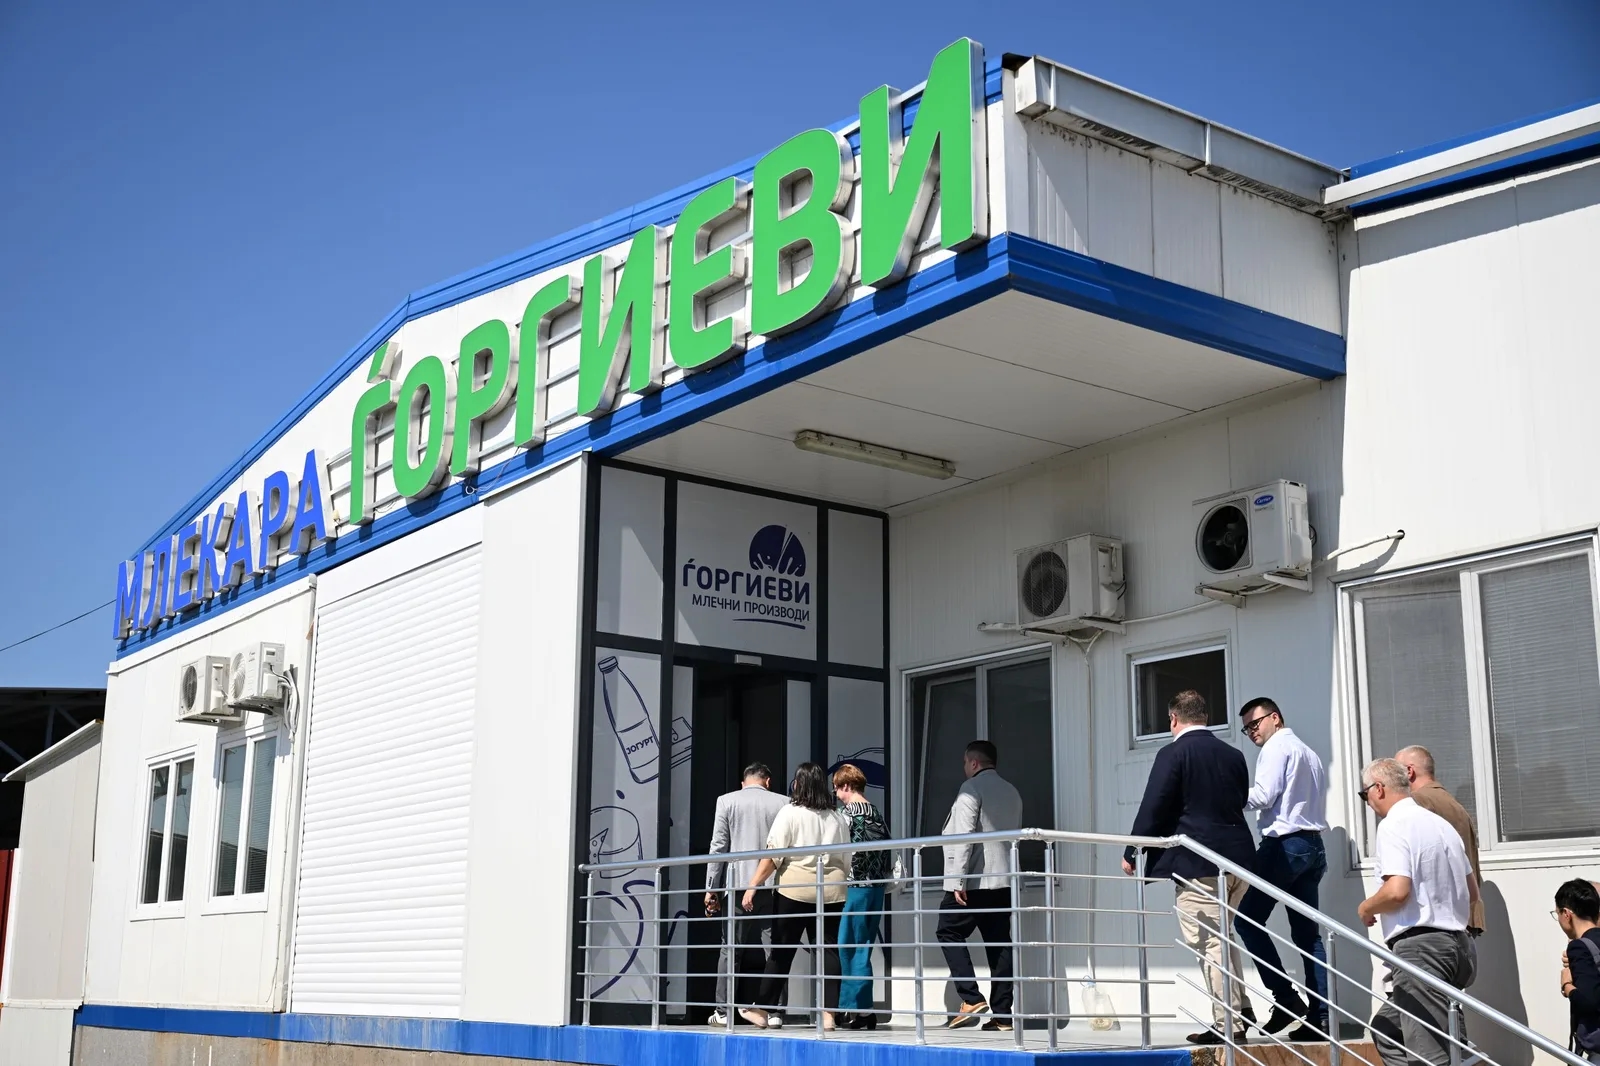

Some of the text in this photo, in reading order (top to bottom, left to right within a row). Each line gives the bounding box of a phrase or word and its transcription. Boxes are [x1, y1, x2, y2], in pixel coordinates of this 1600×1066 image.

[113, 36, 982, 641] МЛЕКАРА ЃОРГИЕВИ
[682, 558, 810, 605] ЃОРГИЕВИ
[692, 594, 810, 622] МЛЕЧНИ ПРОИЗВОДИ
[625, 735, 654, 755] ЈОГУРТ
